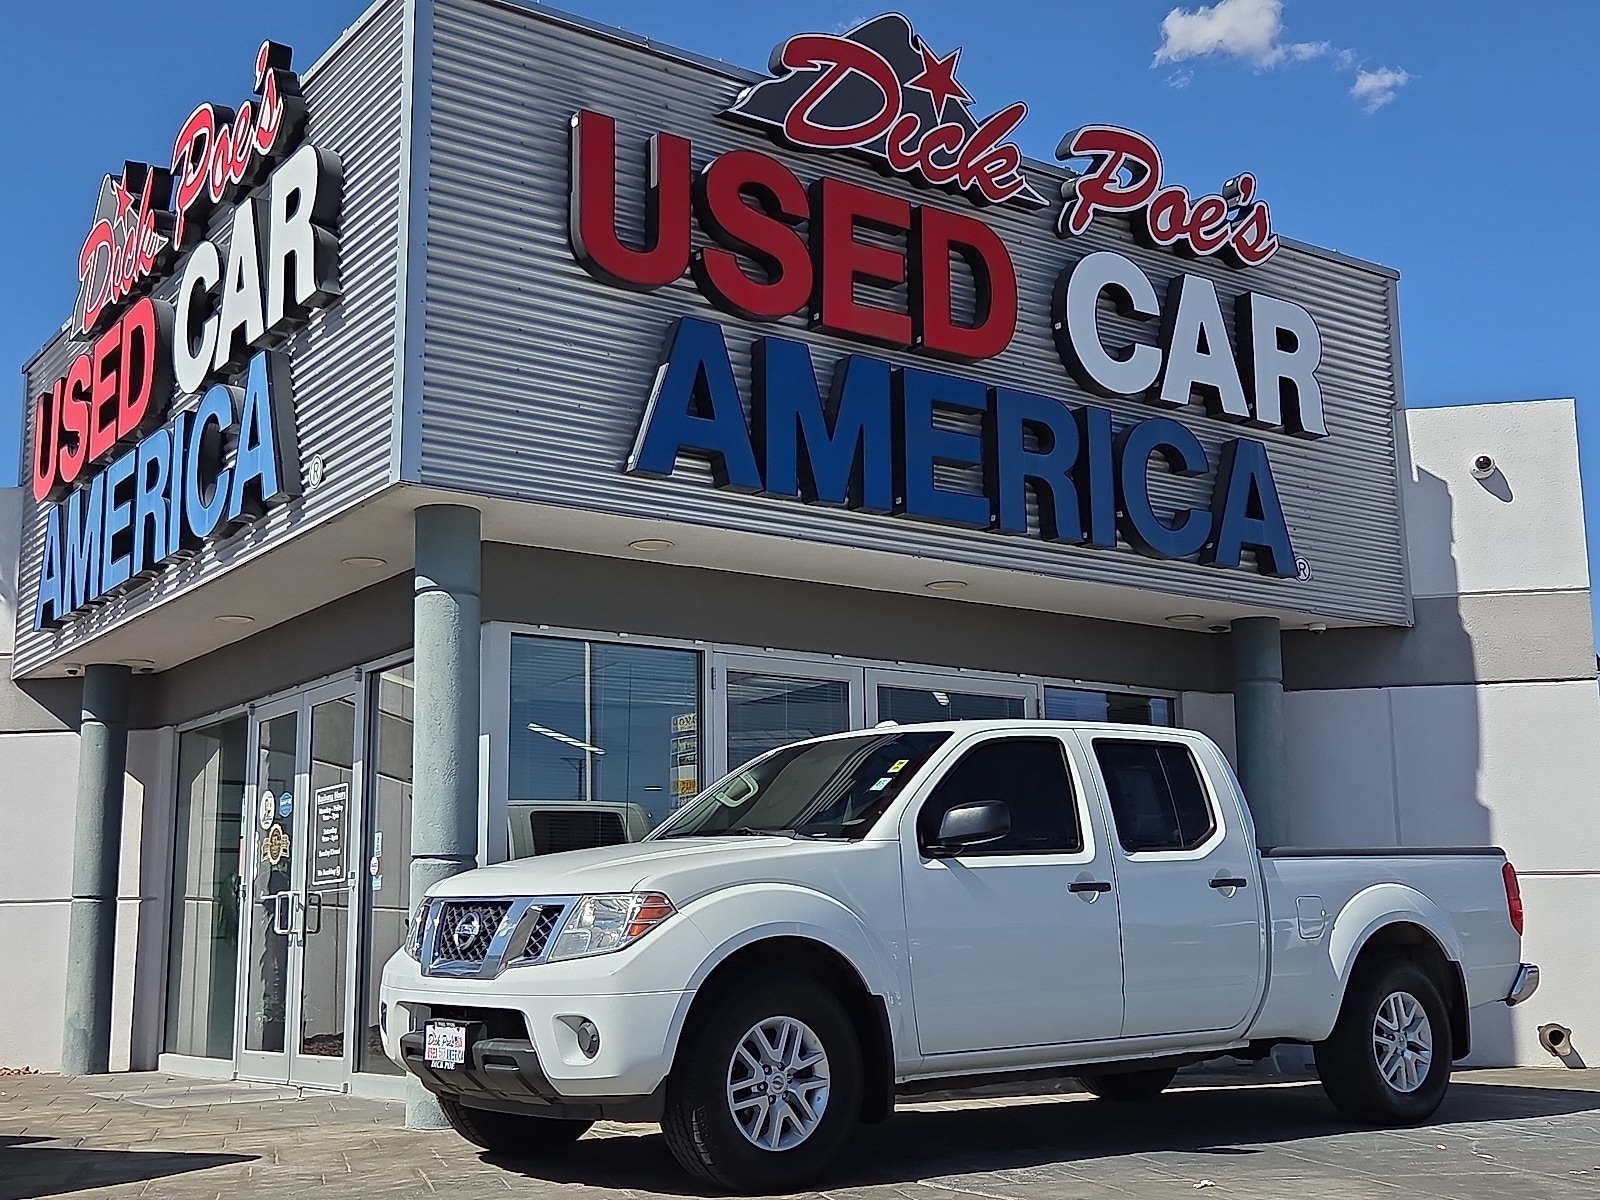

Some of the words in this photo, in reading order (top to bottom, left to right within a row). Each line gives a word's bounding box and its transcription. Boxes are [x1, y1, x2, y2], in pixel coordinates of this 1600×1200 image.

[79, 166, 159, 334] Dick
[171, 40, 286, 251] Poe's
[571, 109, 1018, 361] USED
[1059, 251, 1329, 438] CAR
[780, 34, 1029, 202] Dick
[1064, 123, 1280, 267] Poe's
[33, 297, 160, 501] USED
[174, 145, 330, 394] CAR
[626, 315, 1298, 578] AMERICA
[34, 350, 285, 631] AMERICA
